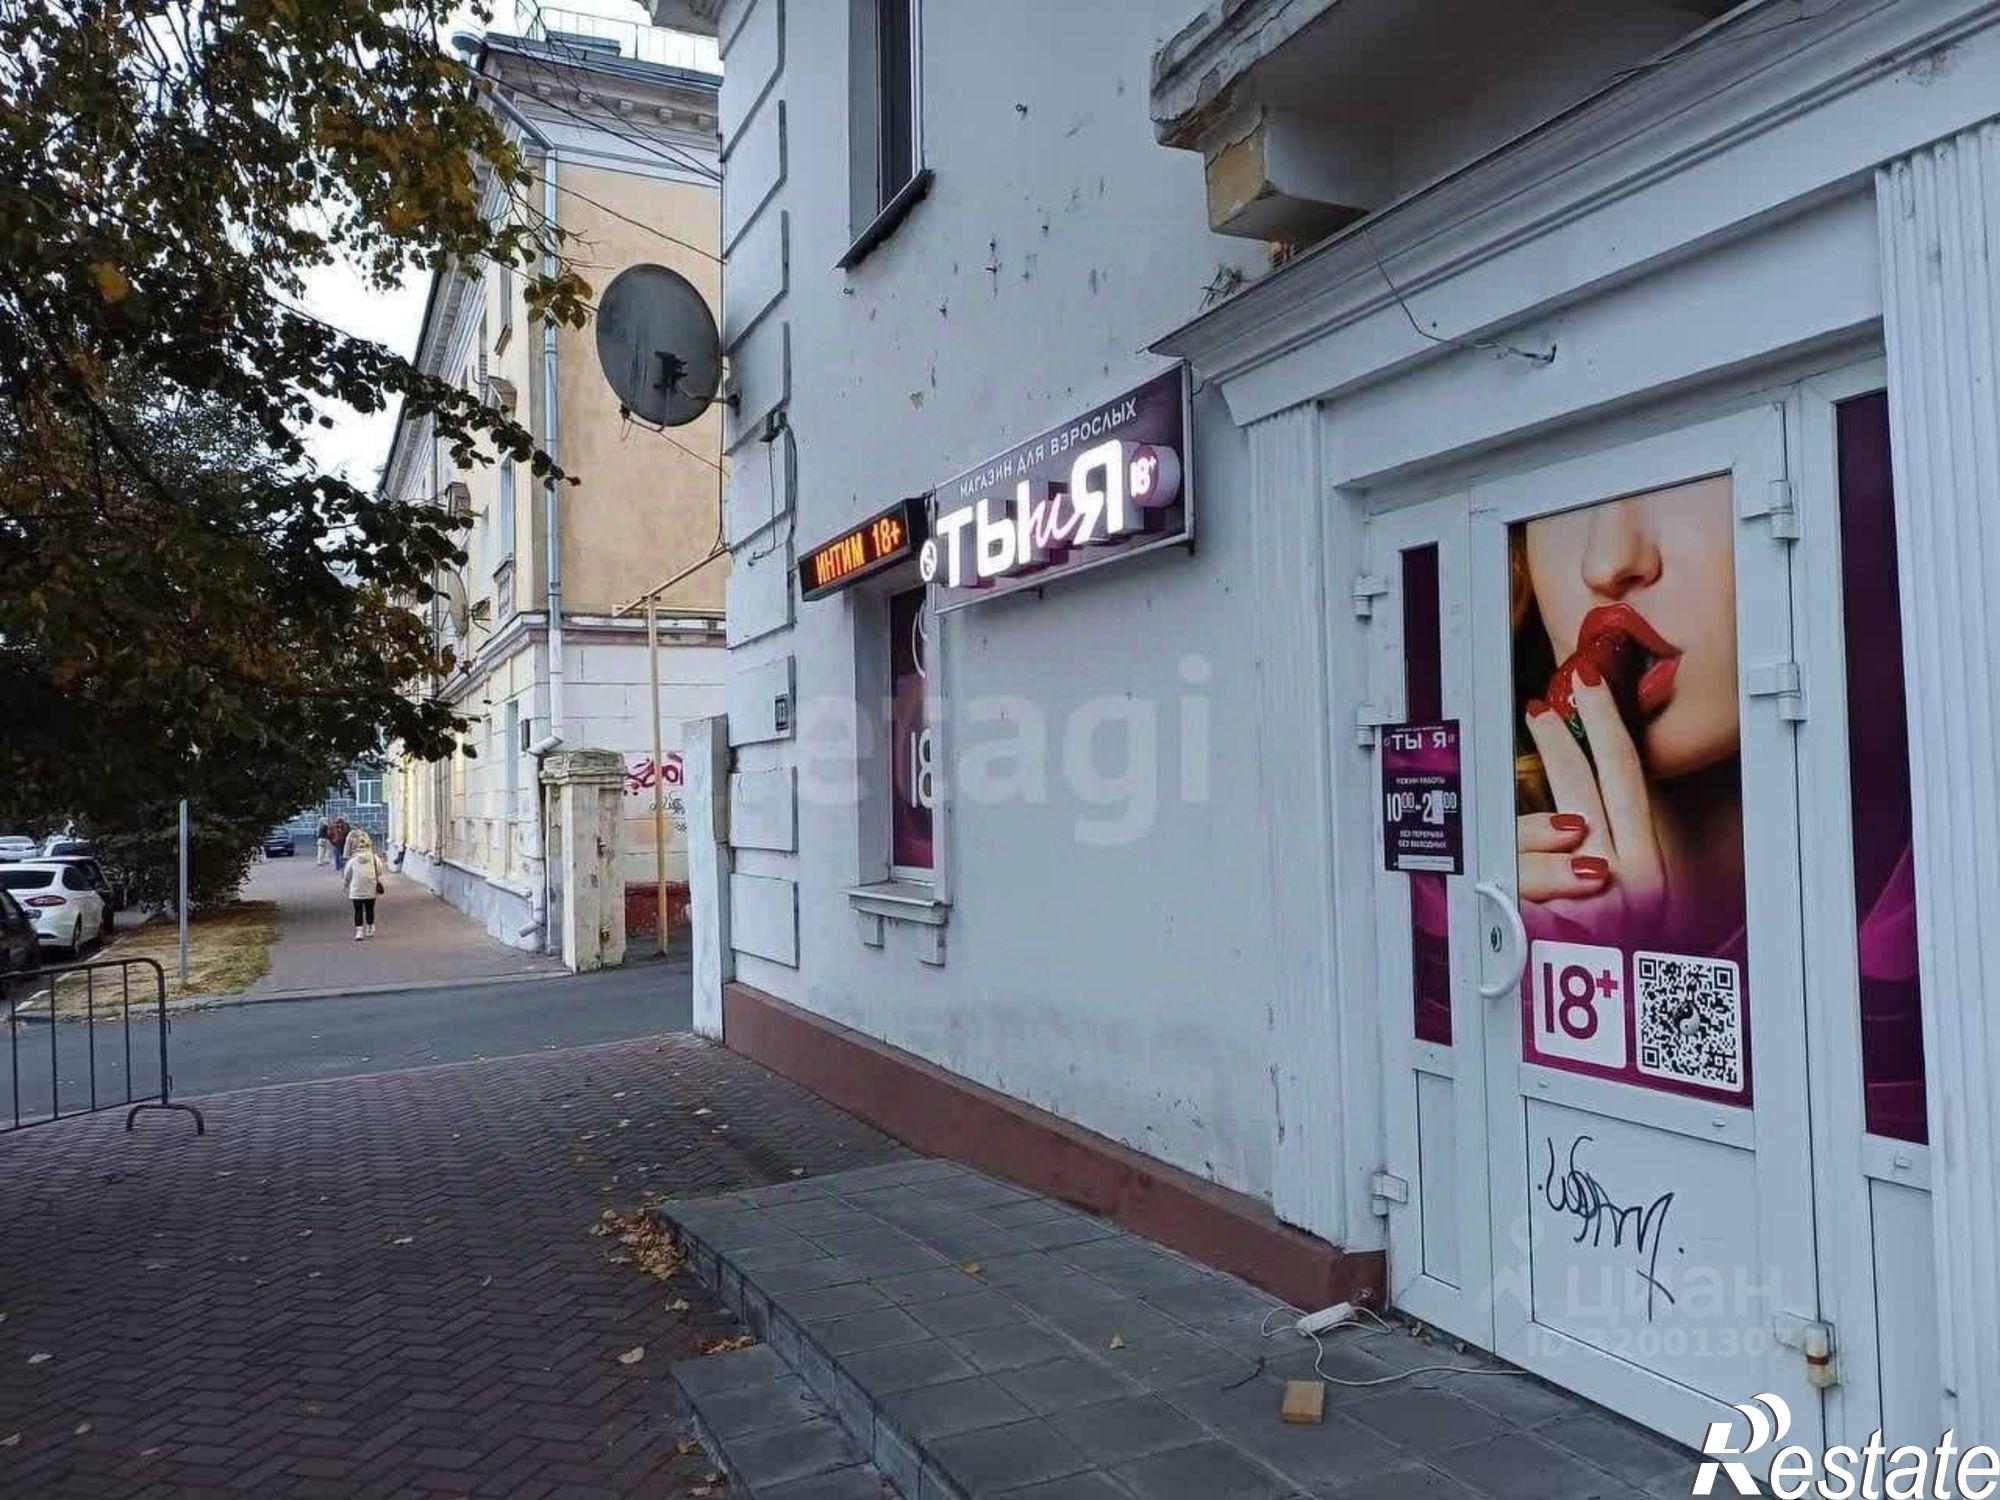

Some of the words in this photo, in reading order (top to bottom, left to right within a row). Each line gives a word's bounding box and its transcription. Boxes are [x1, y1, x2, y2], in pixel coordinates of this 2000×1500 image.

[960, 462, 1013, 499] МАГАЗИН
[1016, 444, 1045, 476] ДЛЯ
[1050, 397, 1137, 456] ВЗРОСЛЫХ
[815, 531, 865, 585] ИНТИМ
[872, 517, 901, 558] 18+
[1543, 962, 1618, 1040] 18+
